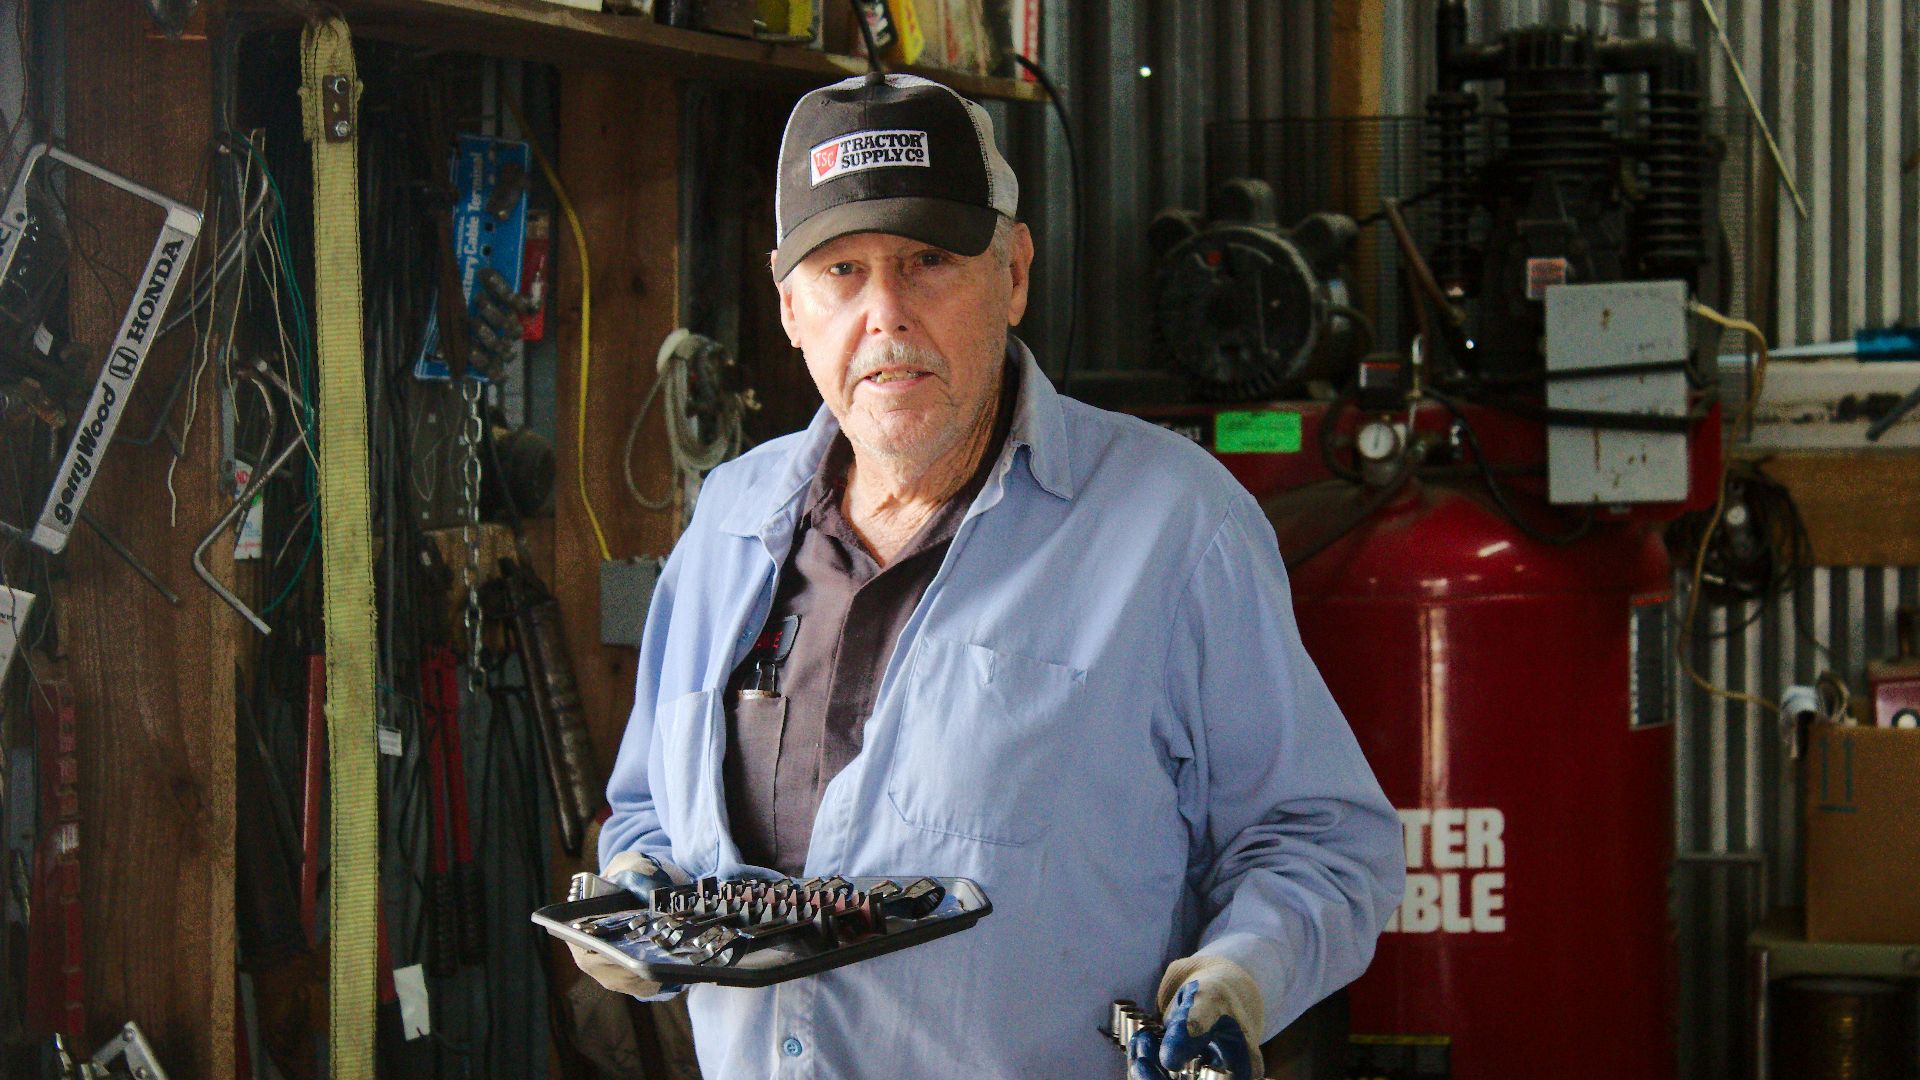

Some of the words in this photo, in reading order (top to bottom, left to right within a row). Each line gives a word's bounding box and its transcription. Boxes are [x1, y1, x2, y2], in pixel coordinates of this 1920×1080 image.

[815, 151, 835, 167] TSC
[840, 133, 922, 154] TRACTOR
[841, 148, 903, 169] SUPPLY
[464, 216, 479, 254] Cable
[126, 239, 184, 345] HONDA
[1397, 808, 1505, 868] TER
[1384, 872, 1505, 933] BLE
